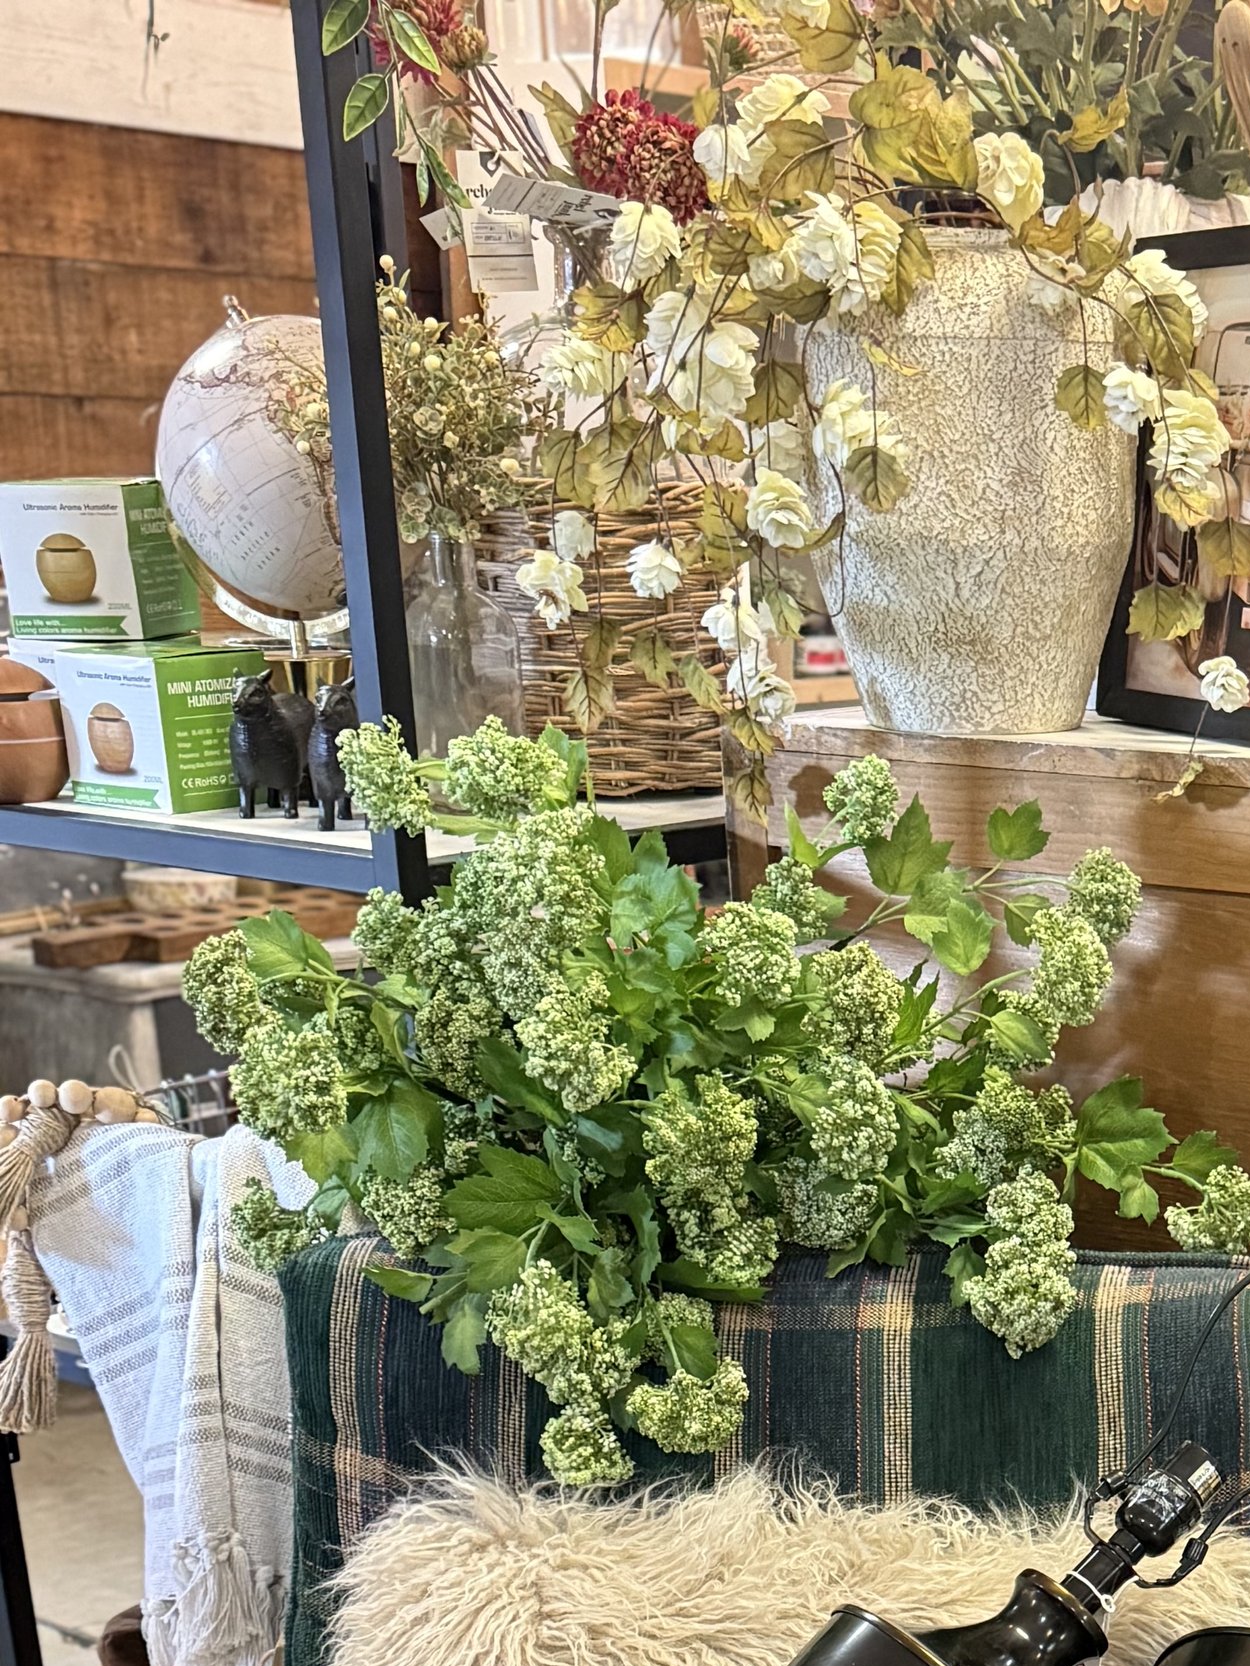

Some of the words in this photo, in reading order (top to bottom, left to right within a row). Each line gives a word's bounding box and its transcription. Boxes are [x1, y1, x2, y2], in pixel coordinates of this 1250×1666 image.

[22, 503, 57, 511] Ultrasonic
[59, 503, 82, 511] Aroma
[83, 503, 119, 511] Humidifier
[167, 681, 192, 695] MINI
